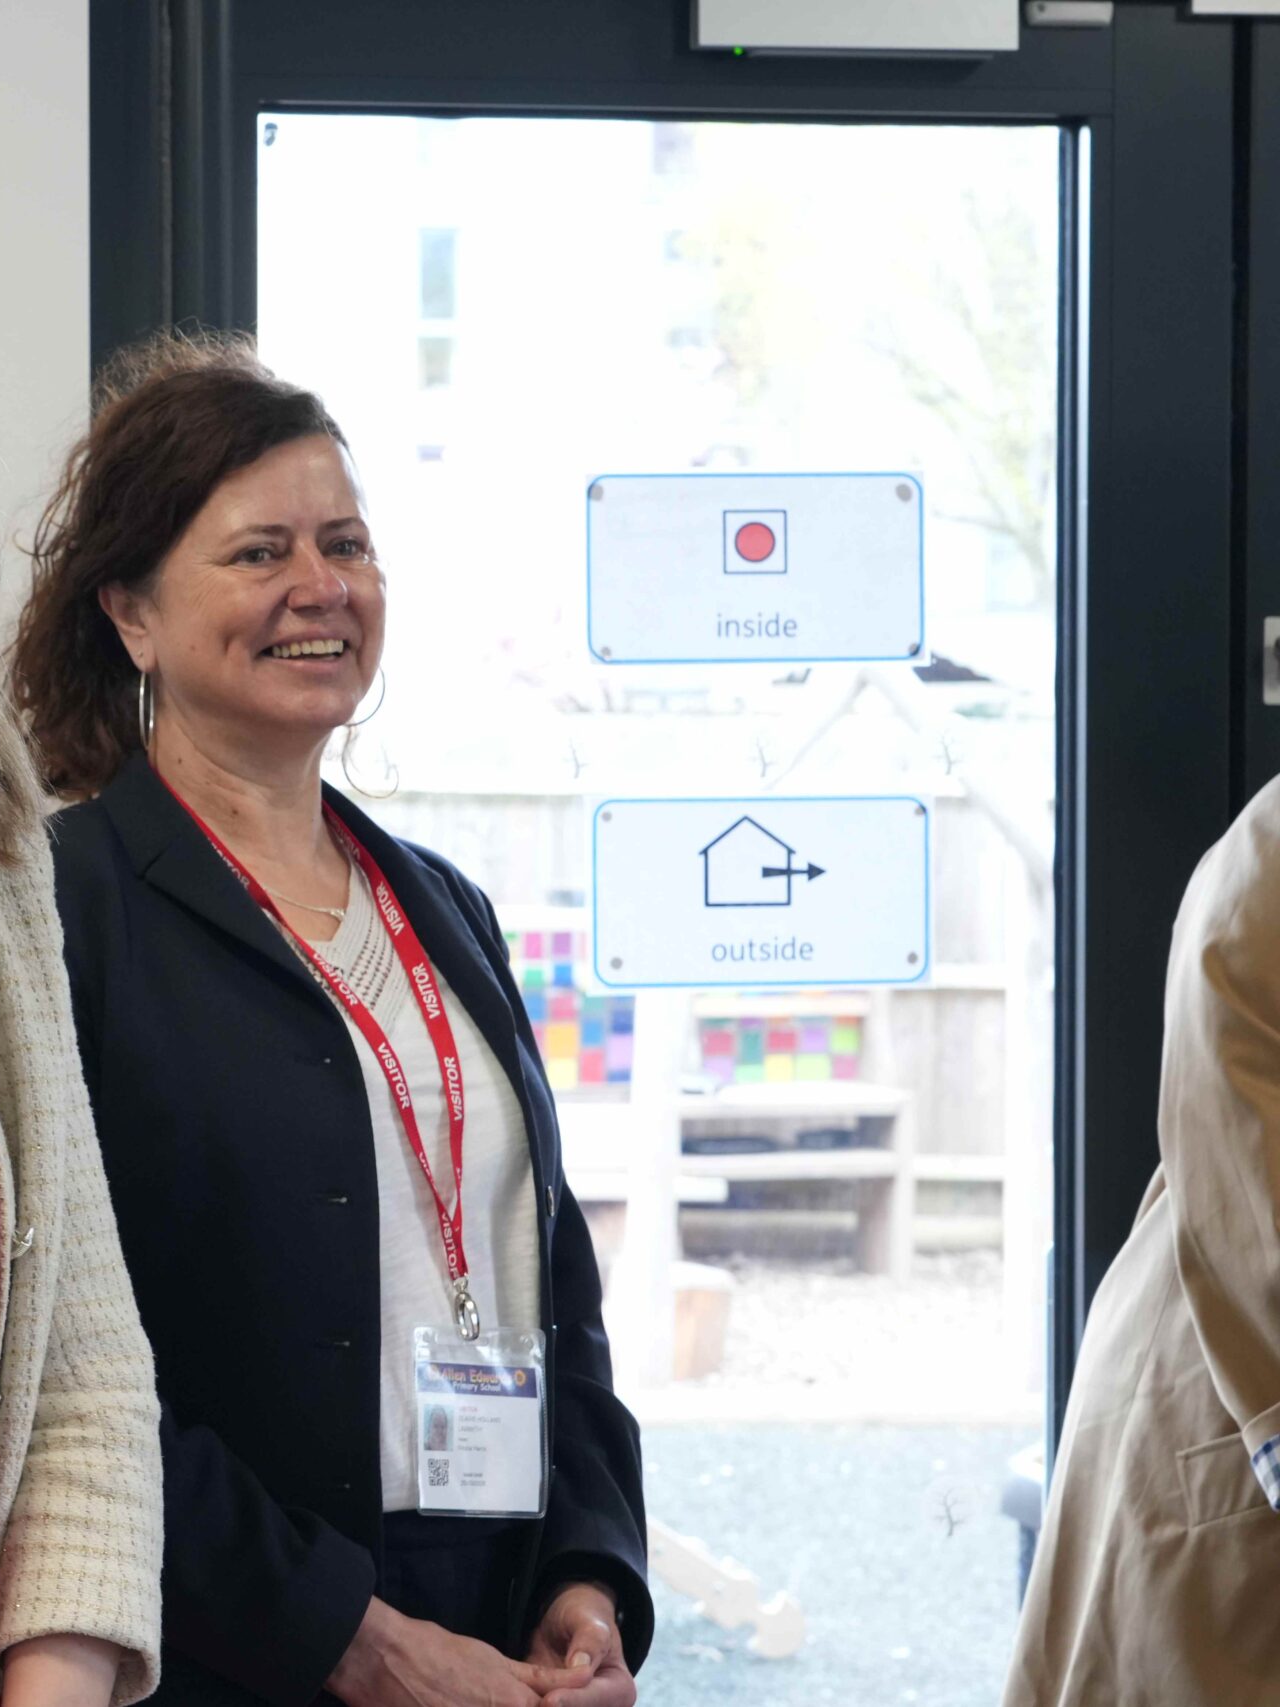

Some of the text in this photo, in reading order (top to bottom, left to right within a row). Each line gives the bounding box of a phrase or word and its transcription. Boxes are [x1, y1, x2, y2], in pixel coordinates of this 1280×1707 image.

[716, 613, 798, 638] inside
[376, 881, 405, 936] VISITOR
[711, 936, 814, 962] outside
[312, 951, 359, 1007] VISITOR
[411, 961, 441, 1020] VISITOR
[377, 1041, 410, 1110] VISITOR
[443, 1056, 463, 1121] VISITOR
[469, 1368, 510, 1384] Edwar
[480, 1383, 502, 1392] School
